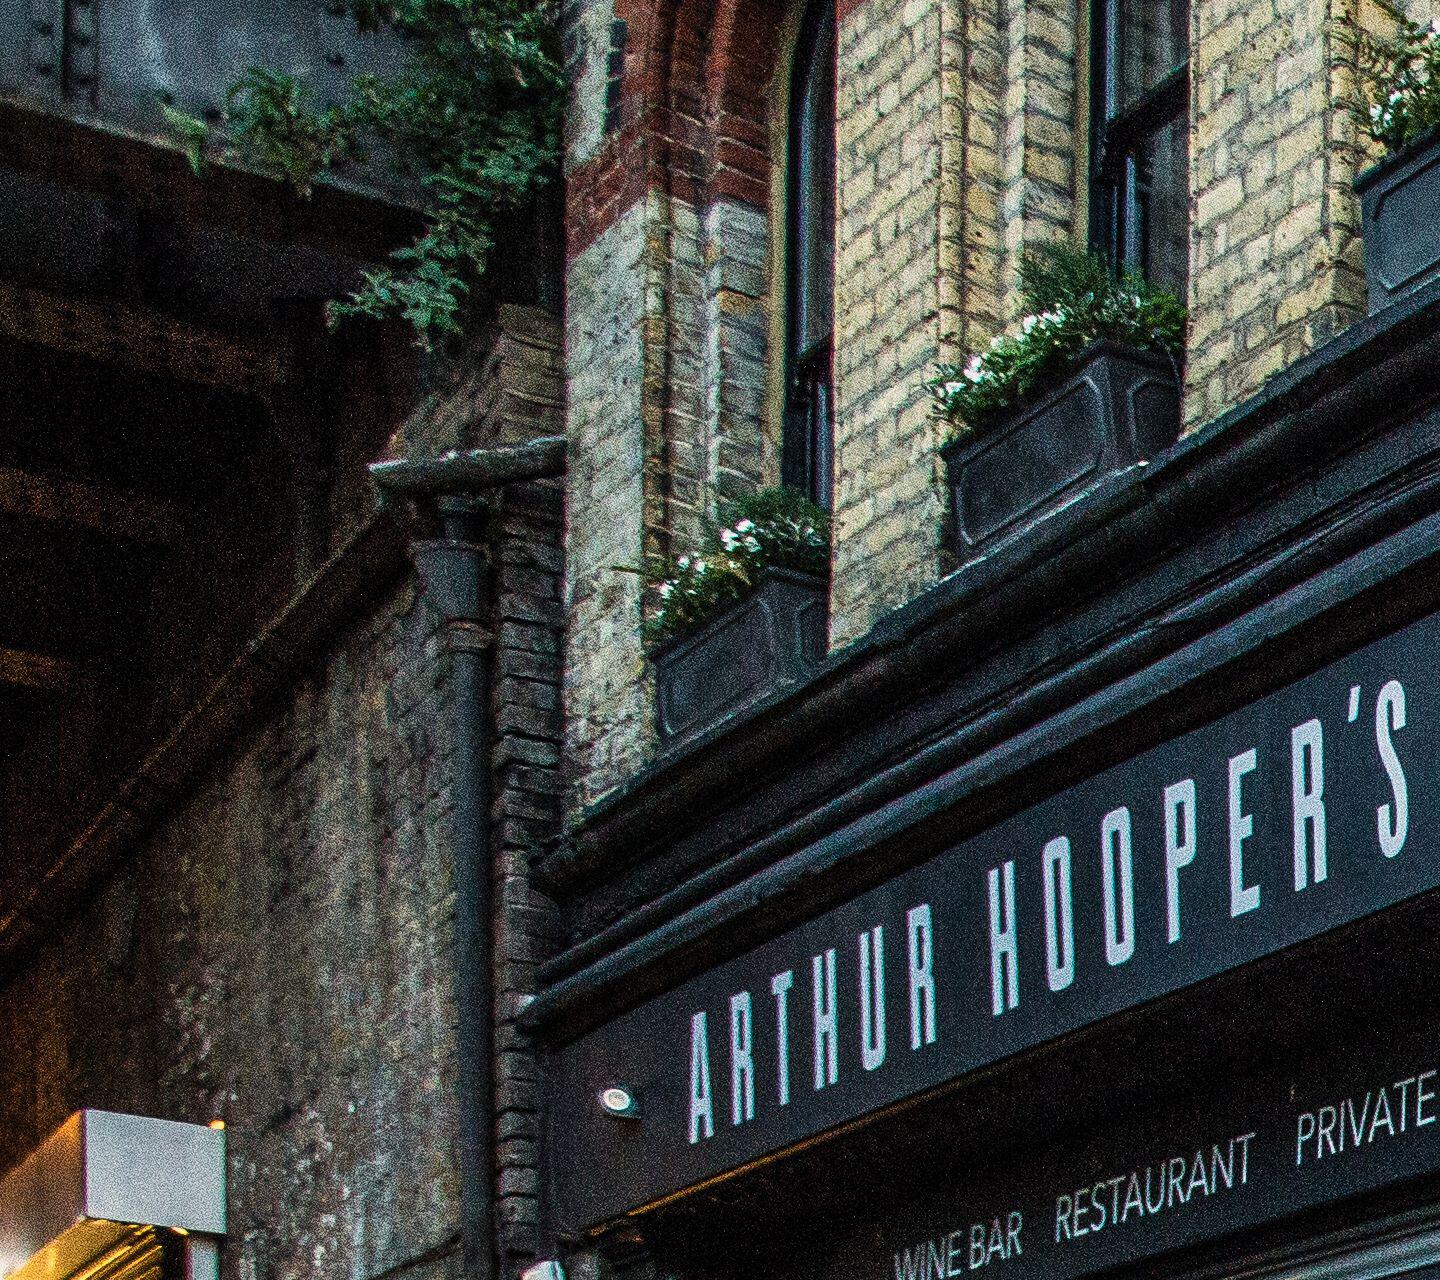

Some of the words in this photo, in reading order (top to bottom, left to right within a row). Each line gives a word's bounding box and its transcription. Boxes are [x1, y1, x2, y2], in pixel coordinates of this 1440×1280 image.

[687, 903, 937, 1144] ARTHUR
[986, 677, 1410, 1018] HOOPER'S
[968, 1211, 1024, 1271] BAR
[1055, 1131, 1257, 1244] RESTAURANT
[1295, 1068, 1437, 1166] PRIVATE
